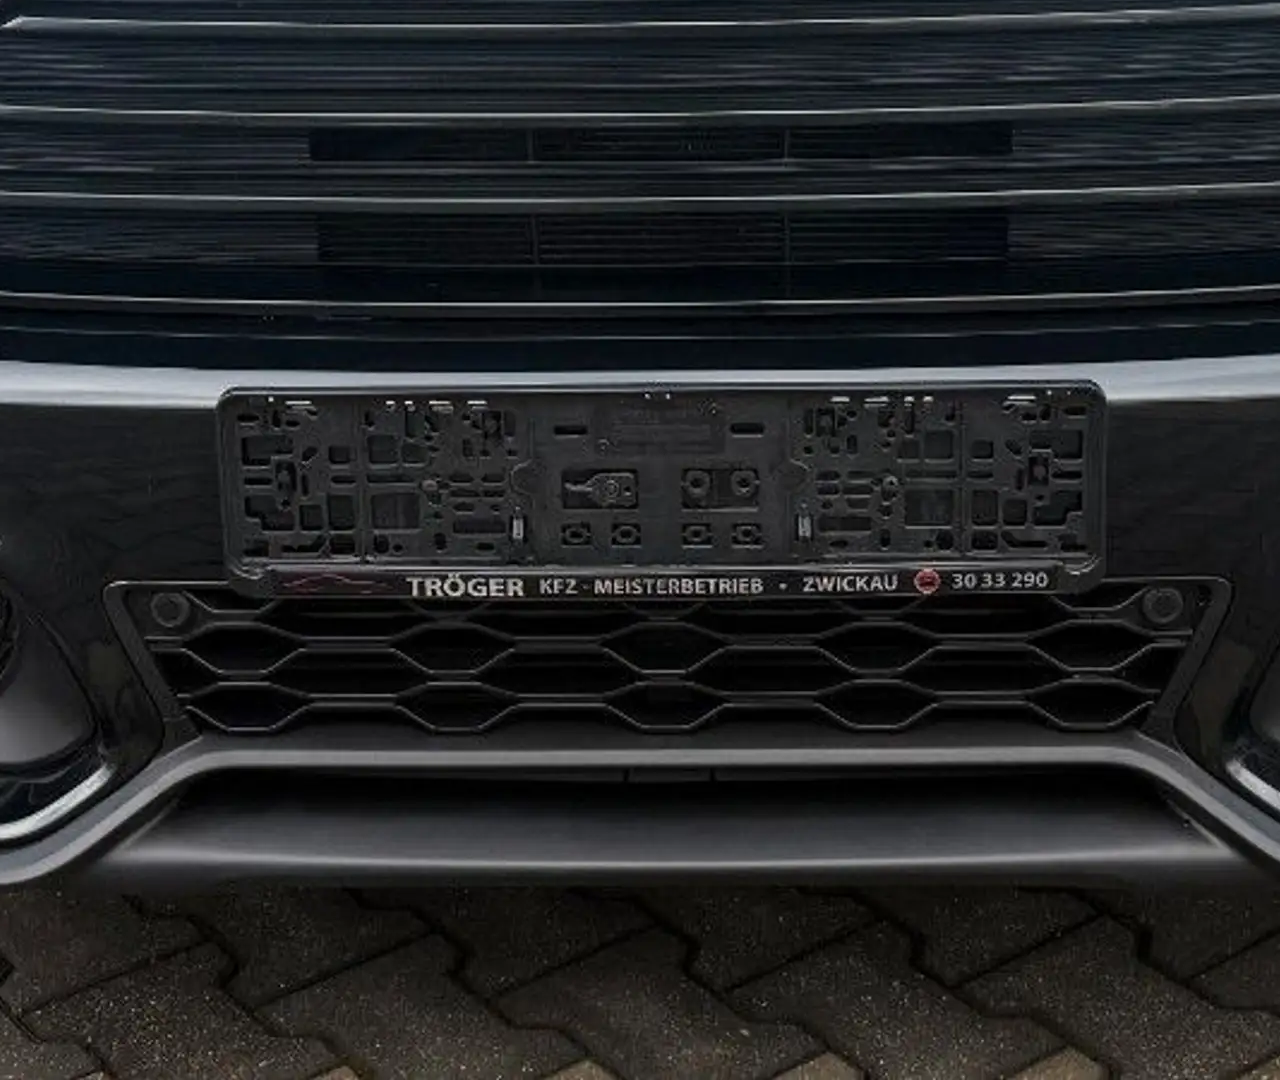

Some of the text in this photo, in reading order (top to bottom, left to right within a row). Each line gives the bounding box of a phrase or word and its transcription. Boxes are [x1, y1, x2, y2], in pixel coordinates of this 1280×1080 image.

[406, 573, 524, 597] TRÖGER
[539, 578, 578, 595] KFZ
[802, 574, 898, 593] ZWICKAU
[951, 573, 976, 589] 30
[980, 573, 1006, 588] 33
[1011, 571, 1049, 588] 290
